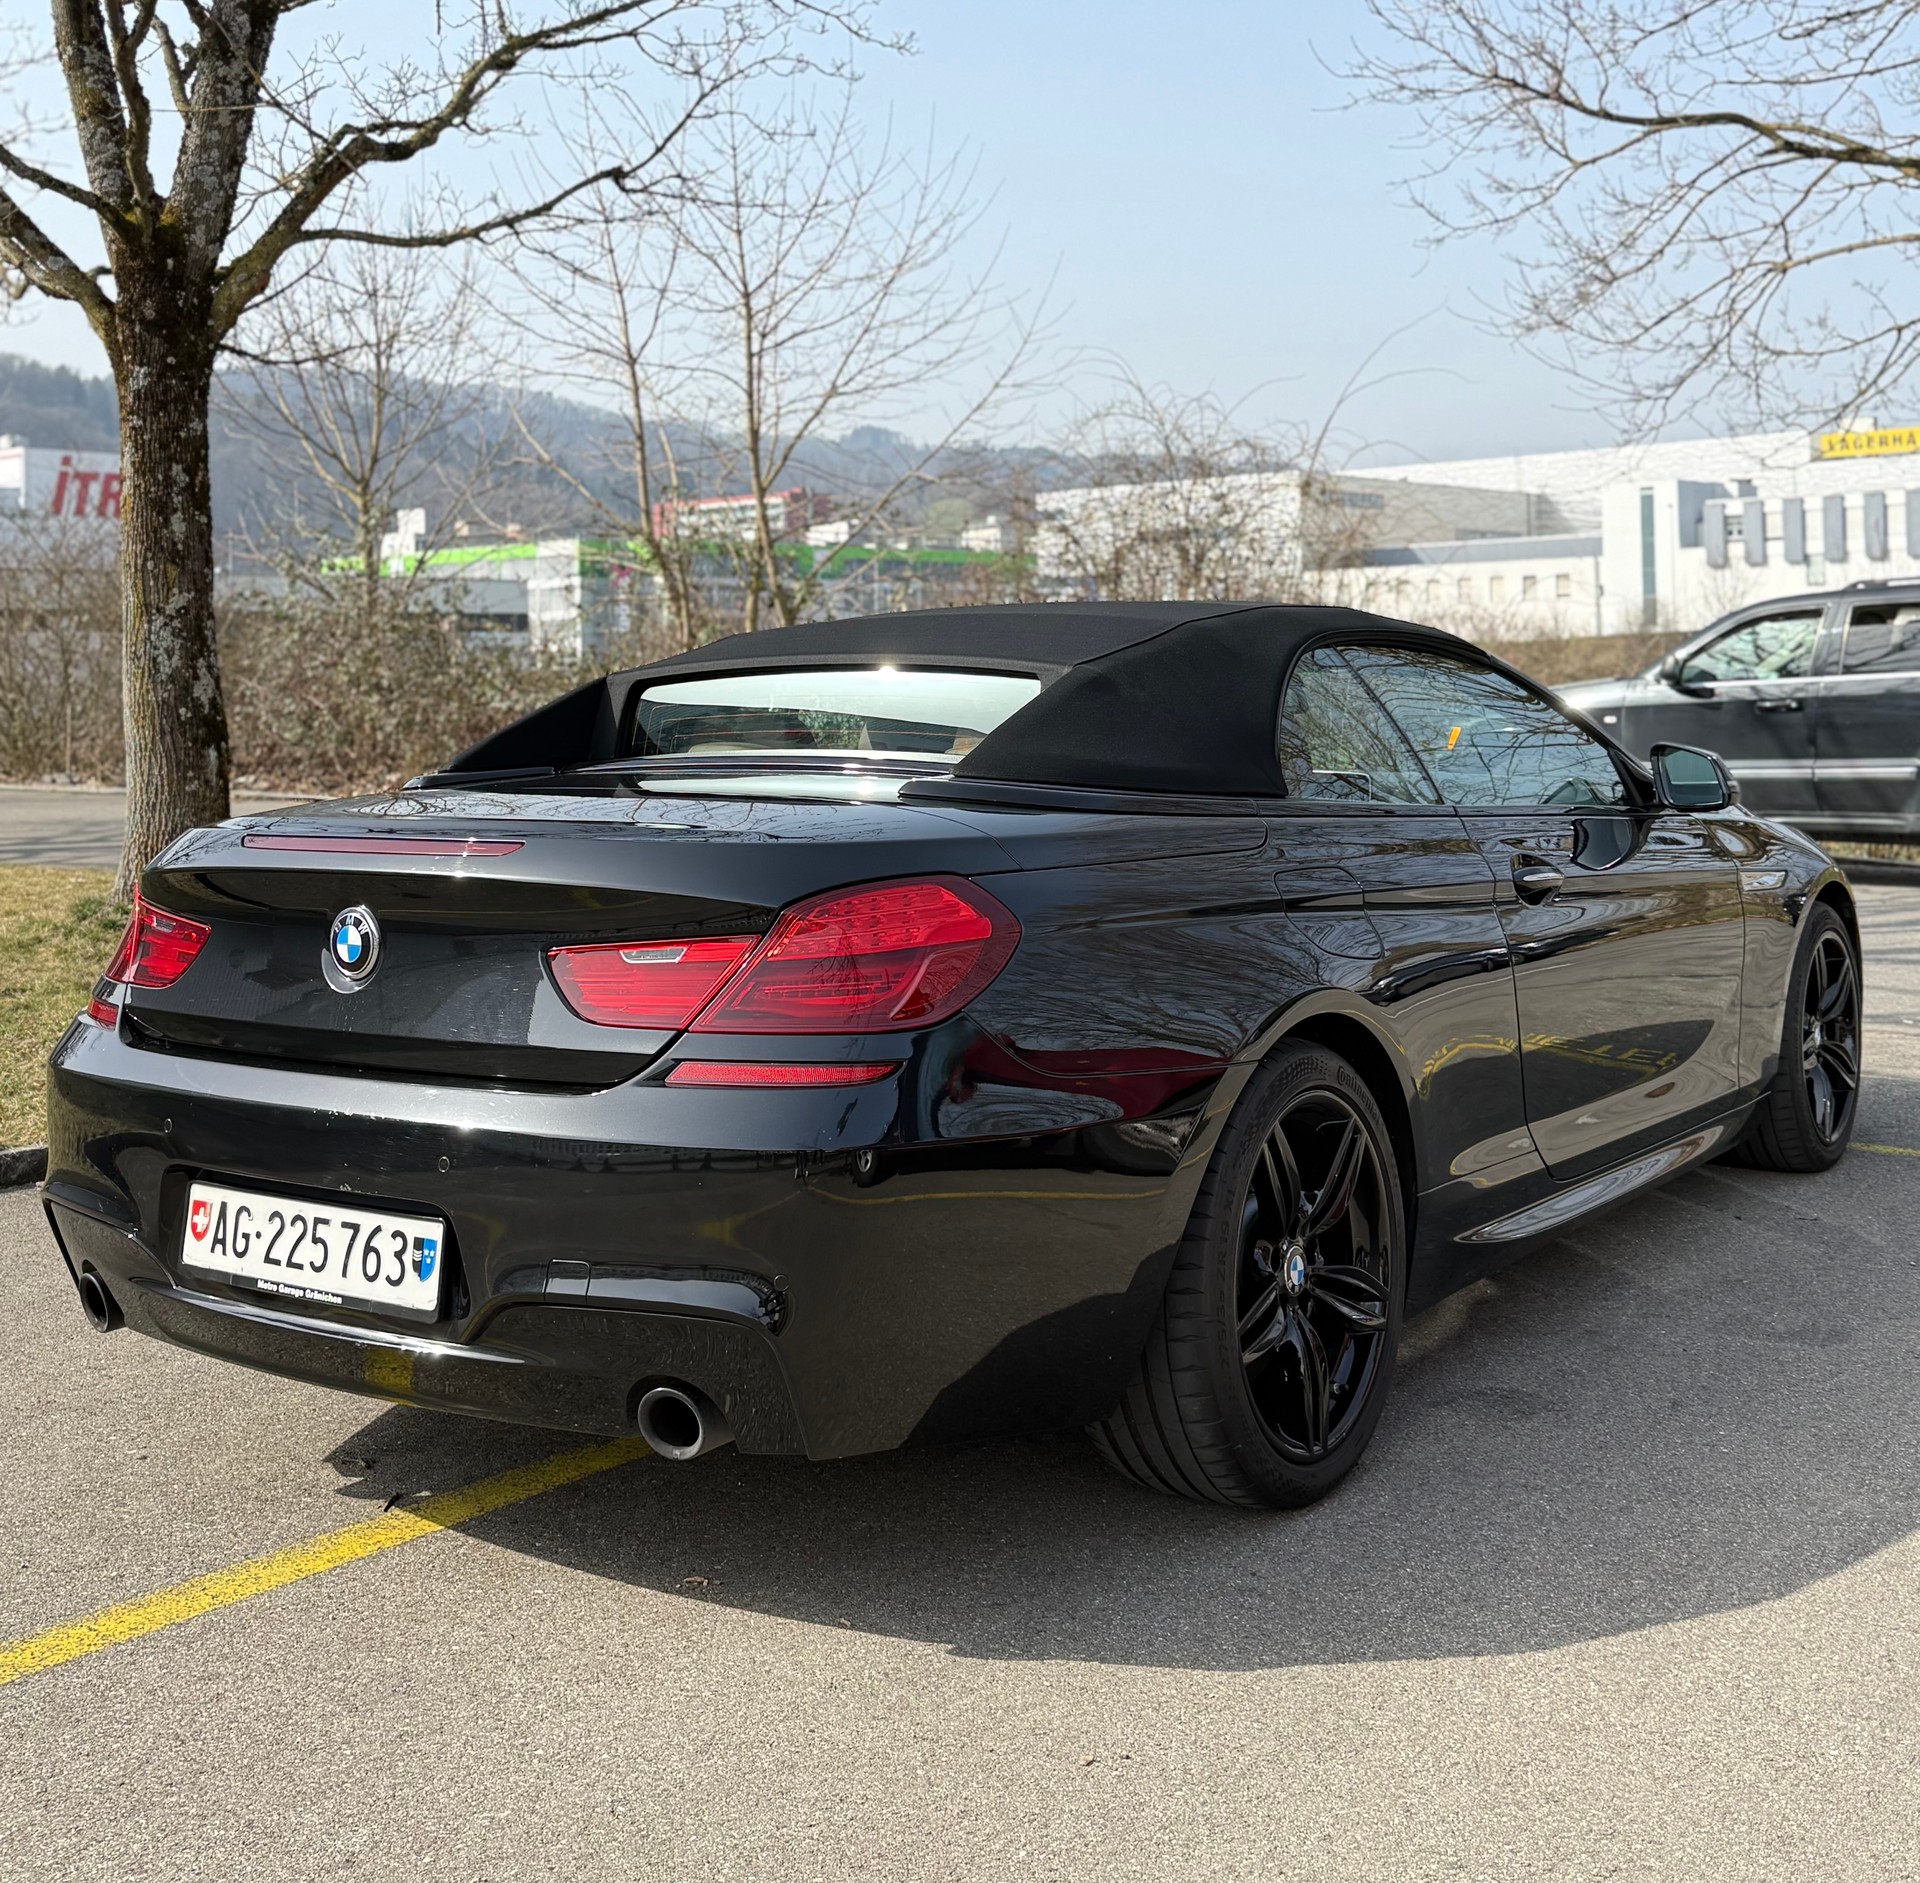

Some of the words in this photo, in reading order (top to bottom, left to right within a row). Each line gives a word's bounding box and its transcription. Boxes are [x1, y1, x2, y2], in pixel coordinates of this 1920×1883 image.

[334, 914, 370, 935] BMW
[1337, 1065, 1379, 1124] Continental
[257, 1279, 278, 1292] Metro
[278, 1284, 304, 1298] Garage
